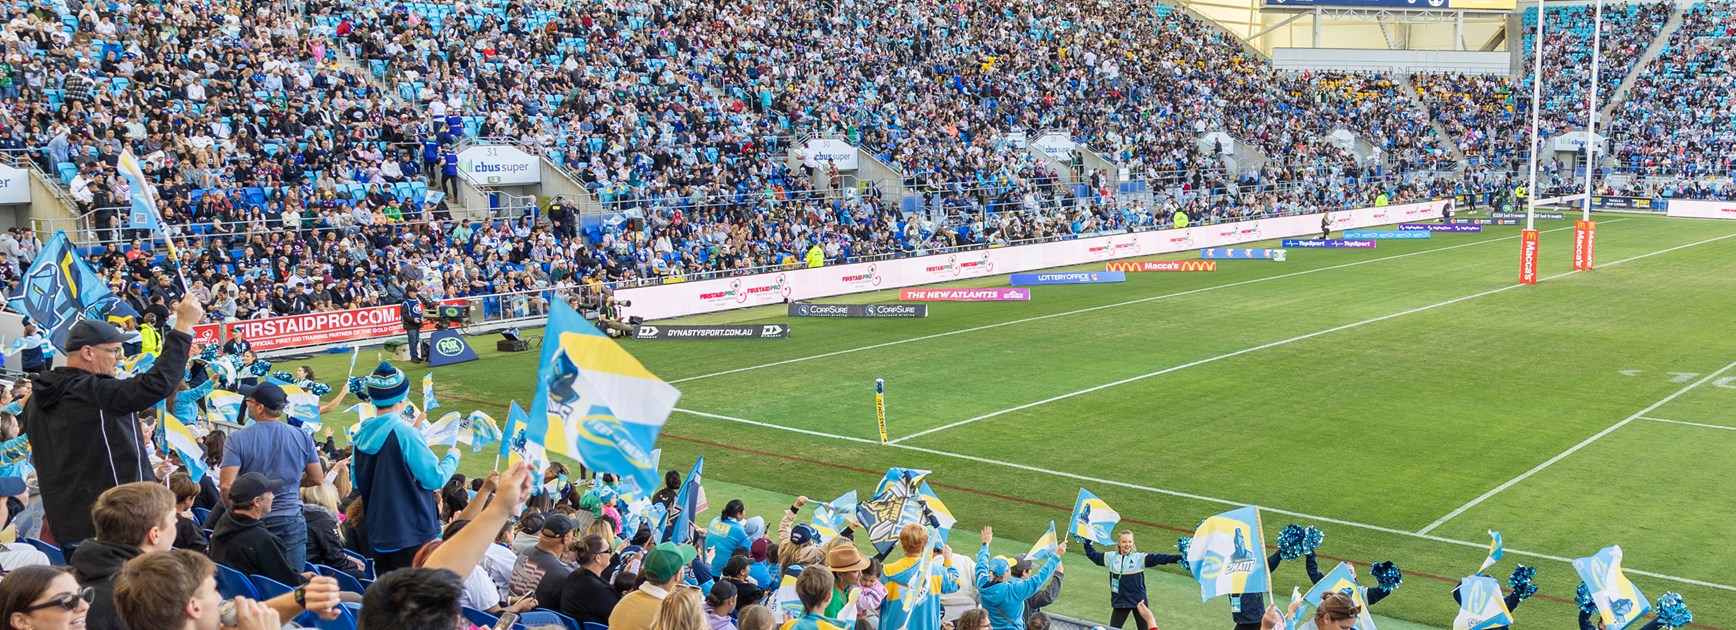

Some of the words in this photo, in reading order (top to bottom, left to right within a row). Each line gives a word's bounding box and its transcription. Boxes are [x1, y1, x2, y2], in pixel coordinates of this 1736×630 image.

[487, 148, 498, 156] 31
[833, 153, 851, 162] super
[475, 162, 500, 172] cbus
[502, 163, 529, 173] super
[1576, 230, 1584, 267] Macca's
[1524, 241, 1535, 282] Macca's
[233, 307, 402, 338] FIRSTAIDPRO.COM.
[249, 340, 275, 348] OFFICIAL
[302, 333, 328, 341] TRAINING
[328, 330, 353, 338] PARTNER
[388, 324, 404, 332] COAST
[667, 328, 753, 337] DYNASTYSPORT.COM.AU
[440, 340, 459, 350] FOX
